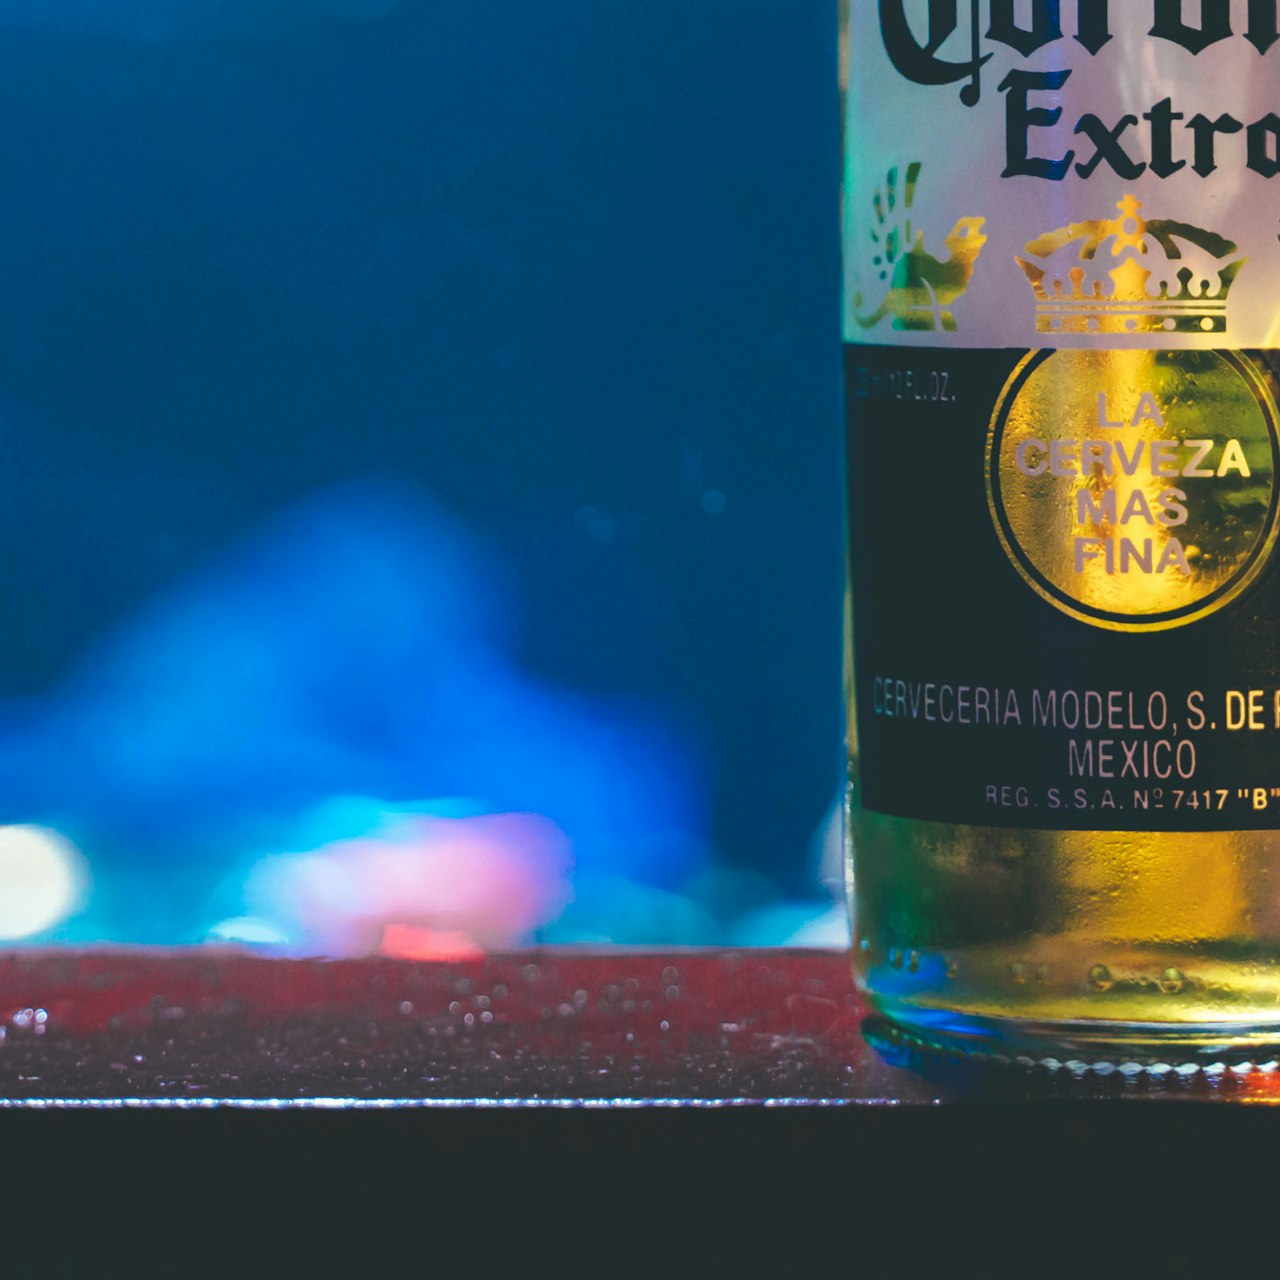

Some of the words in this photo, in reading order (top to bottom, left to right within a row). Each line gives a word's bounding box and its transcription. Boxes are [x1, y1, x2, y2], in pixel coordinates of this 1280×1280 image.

[1096, 391, 1165, 428] LA
[1015, 438, 1251, 478] CERVEZA
[1076, 487, 1189, 527] MAS
[1074, 537, 1191, 575] FINA
[873, 676, 1021, 726] CERVECERIA
[1032, 688, 1177, 736] MODELO,
[1187, 691, 1216, 730] S.
[1225, 690, 1265, 730] DE
[1068, 739, 1196, 779] MEXICO
[986, 784, 1039, 808] REG.
[1172, 789, 1229, 811] 7417
